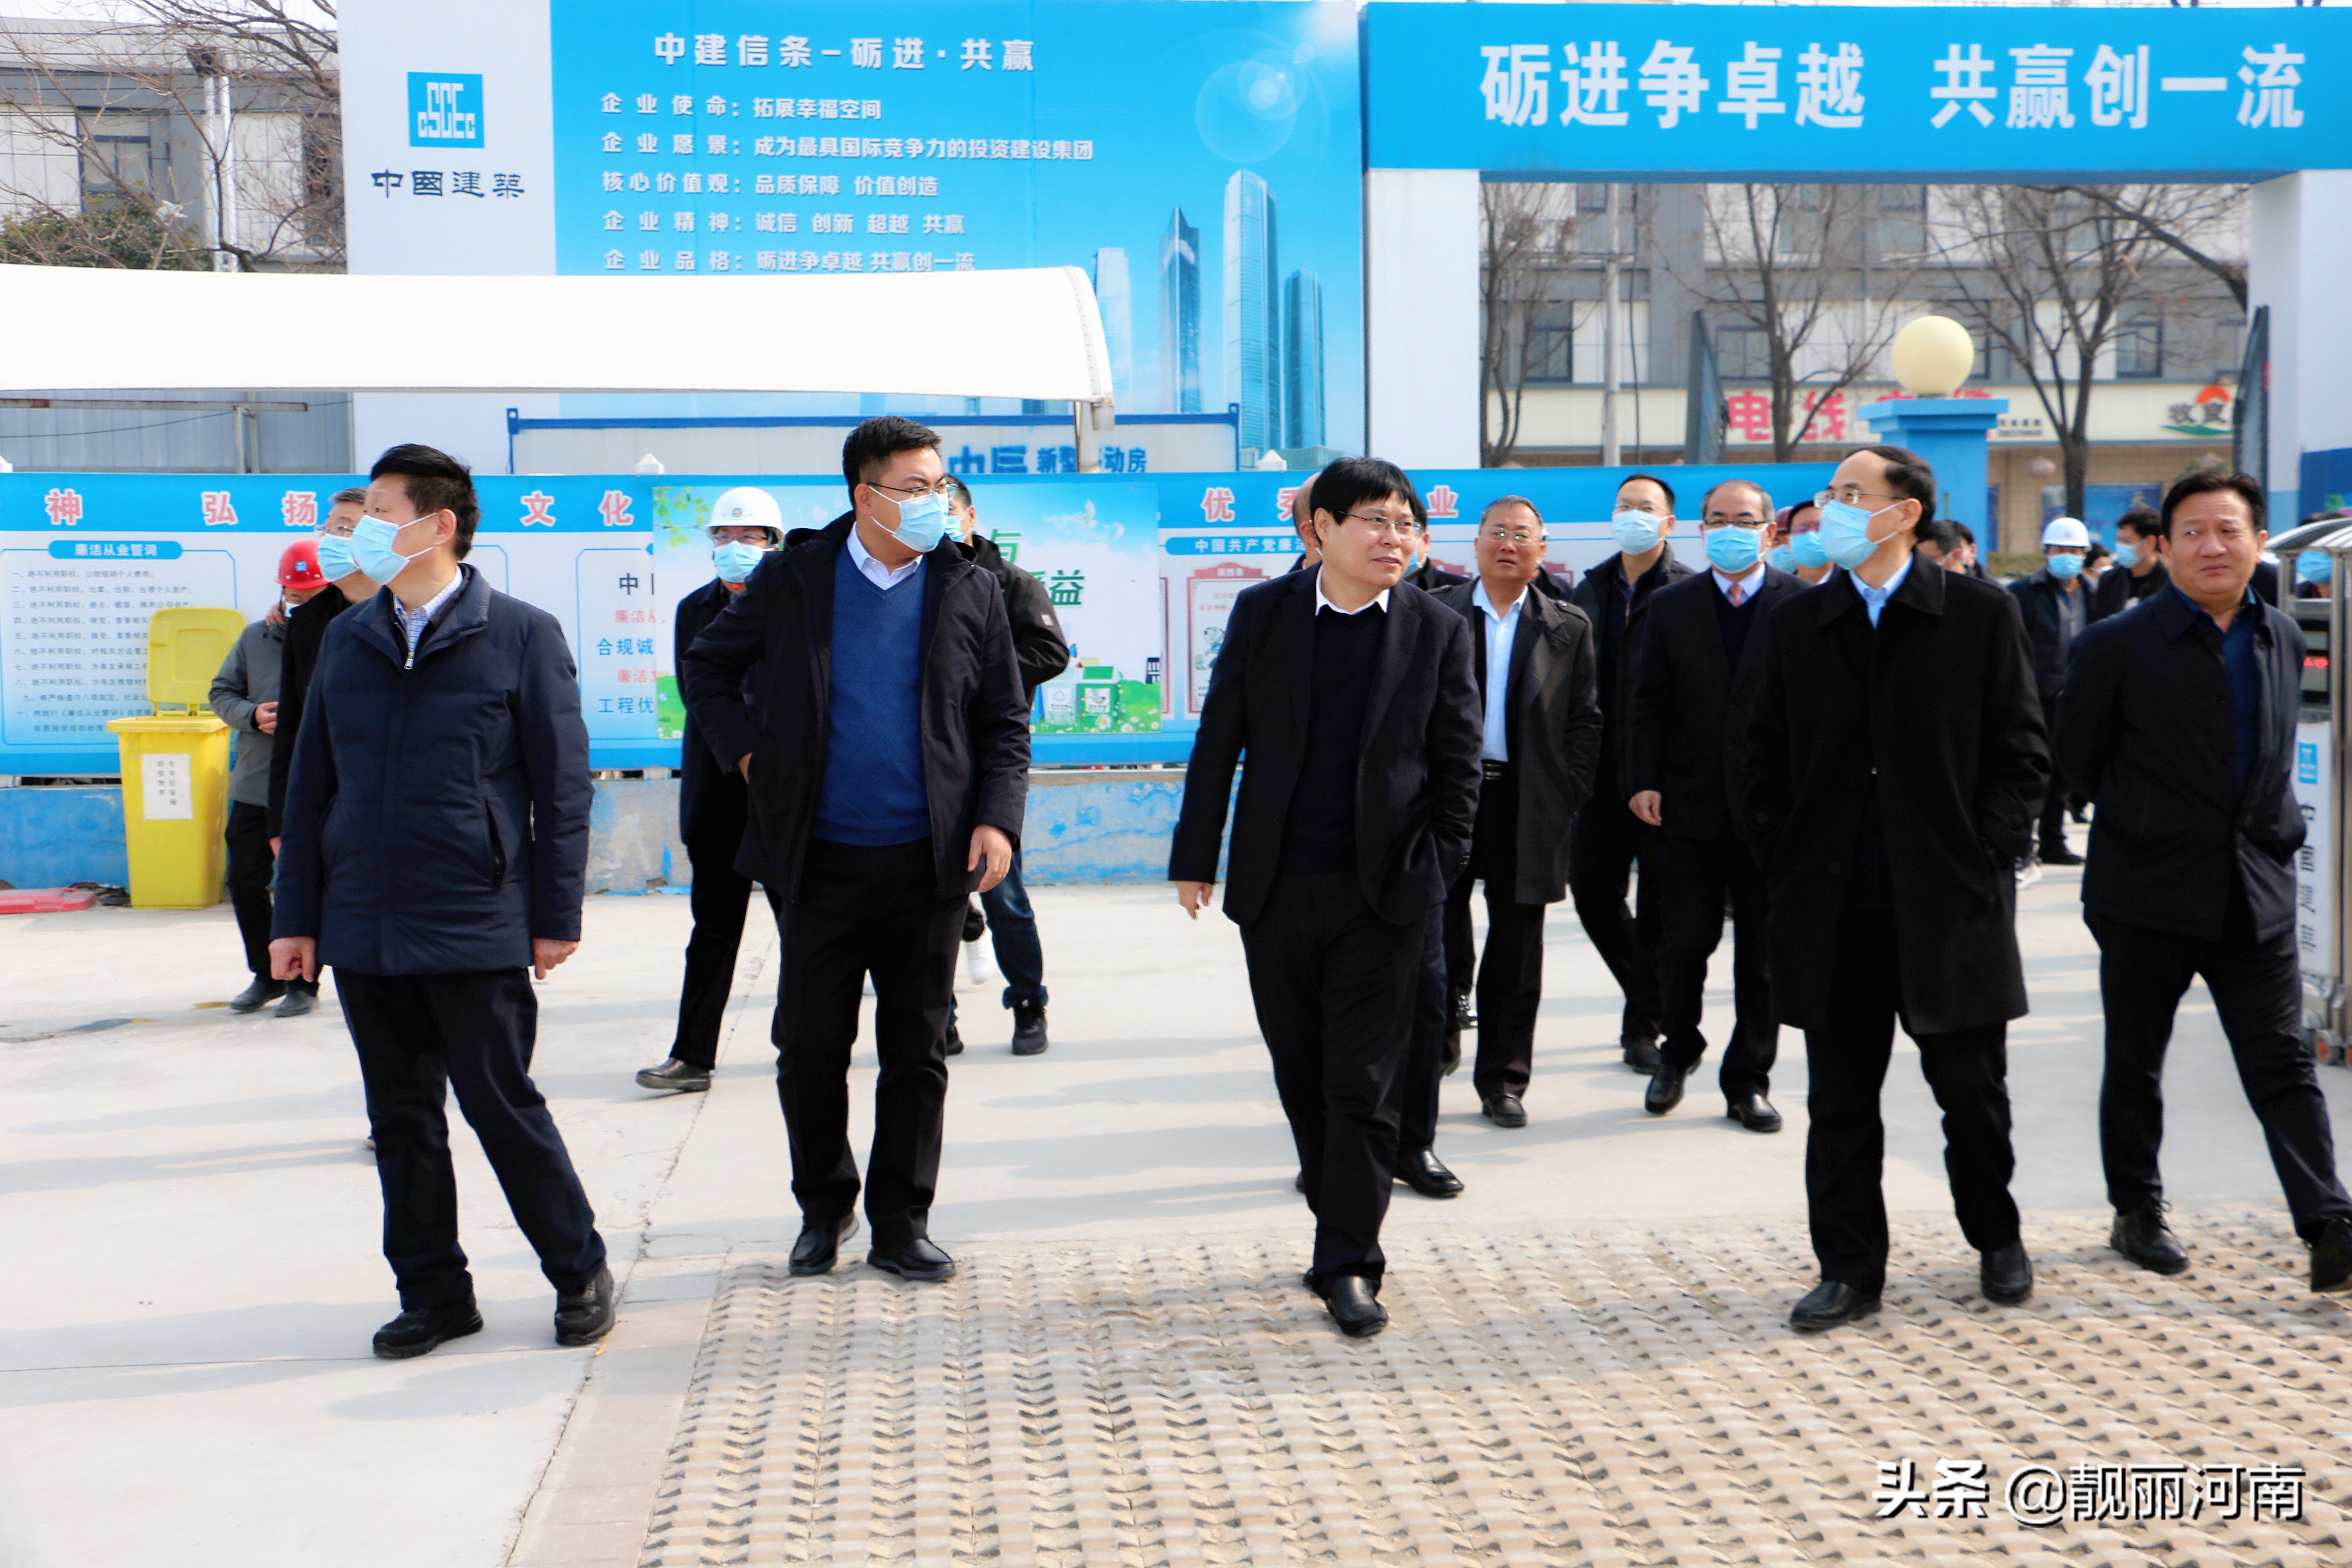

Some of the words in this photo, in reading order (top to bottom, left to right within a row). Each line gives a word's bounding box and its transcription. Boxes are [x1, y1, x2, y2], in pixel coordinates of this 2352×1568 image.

[1480, 40, 1865, 129] 砺进争卓越
[1930, 43, 2305, 129] 共赢创一流
[418, 82, 475, 138] CSCEC
[854, 175, 939, 197] 价值创造
[812, 213, 854, 234] 创新
[867, 214, 910, 234] 超越
[923, 214, 965, 235] 共赢
[1037, 446, 1147, 473] 新型动房
[75, 543, 157, 557] 廉洁从业誓词
